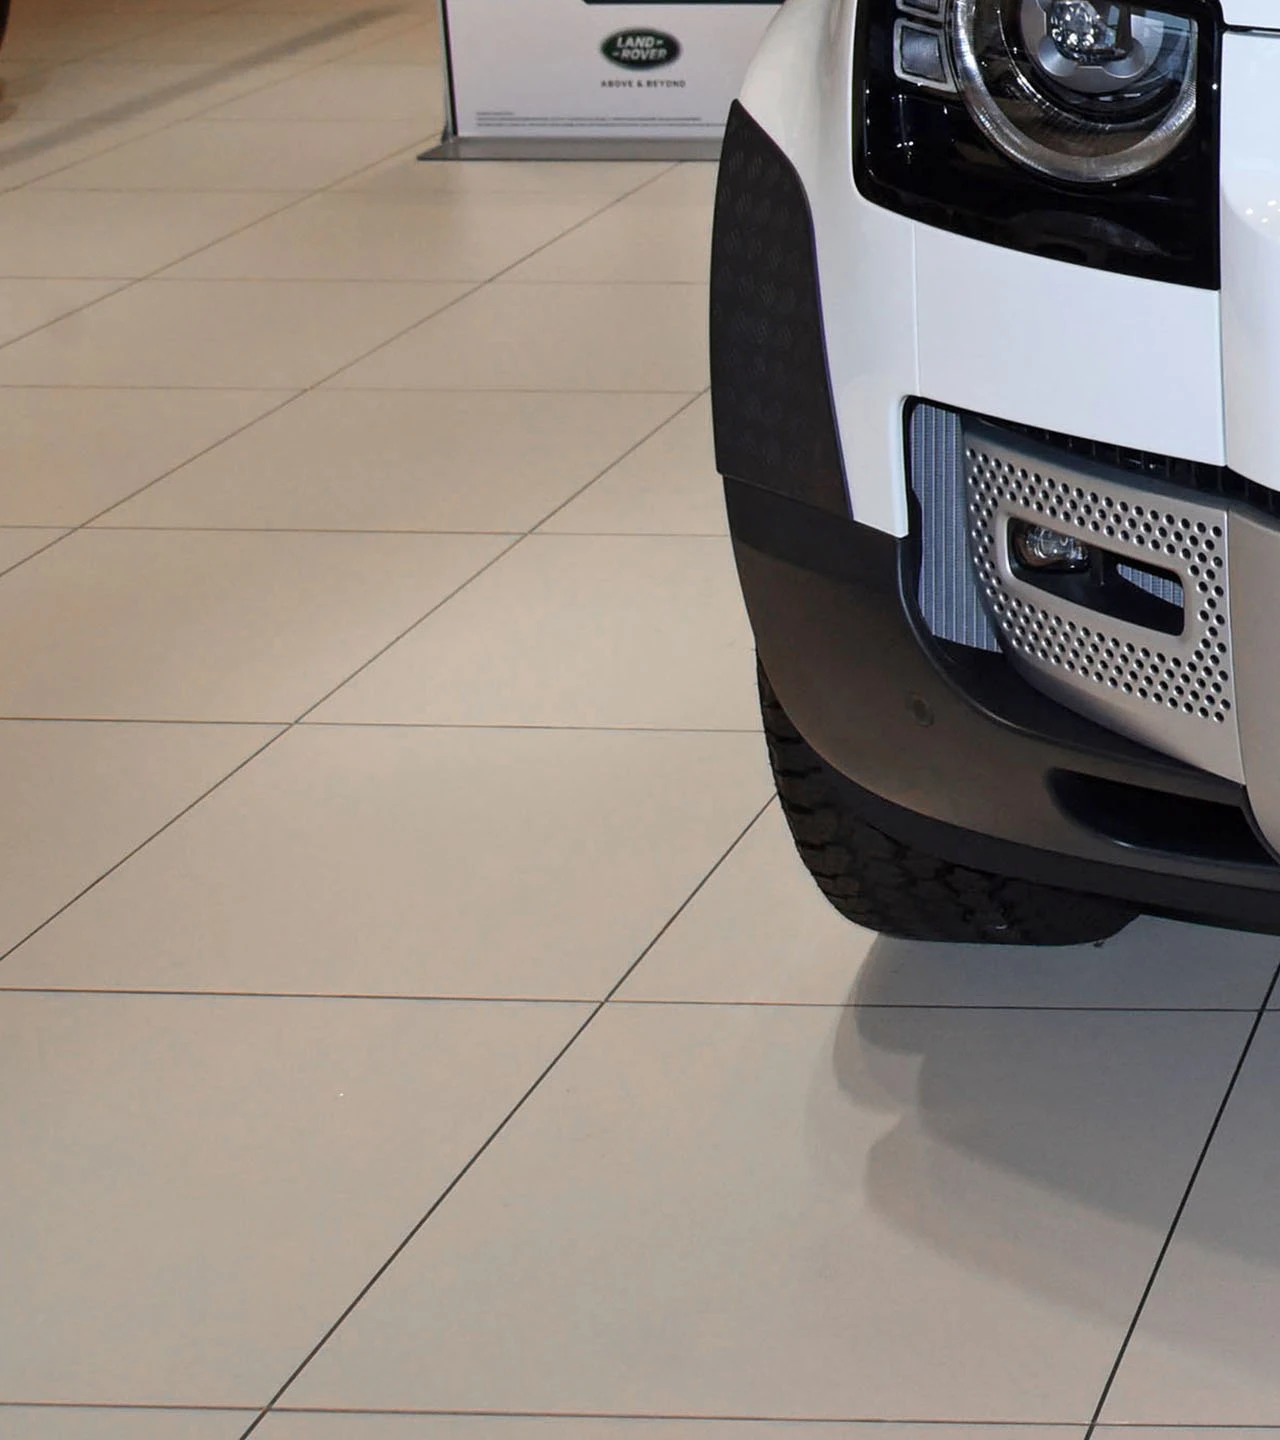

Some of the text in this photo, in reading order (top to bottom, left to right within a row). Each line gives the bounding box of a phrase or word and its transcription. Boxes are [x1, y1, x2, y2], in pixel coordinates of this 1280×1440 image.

[616, 35, 655, 48] LAND
[620, 48, 667, 60] ROVER
[601, 80, 632, 88] ABOVE
[646, 80, 686, 88] BEYOND
